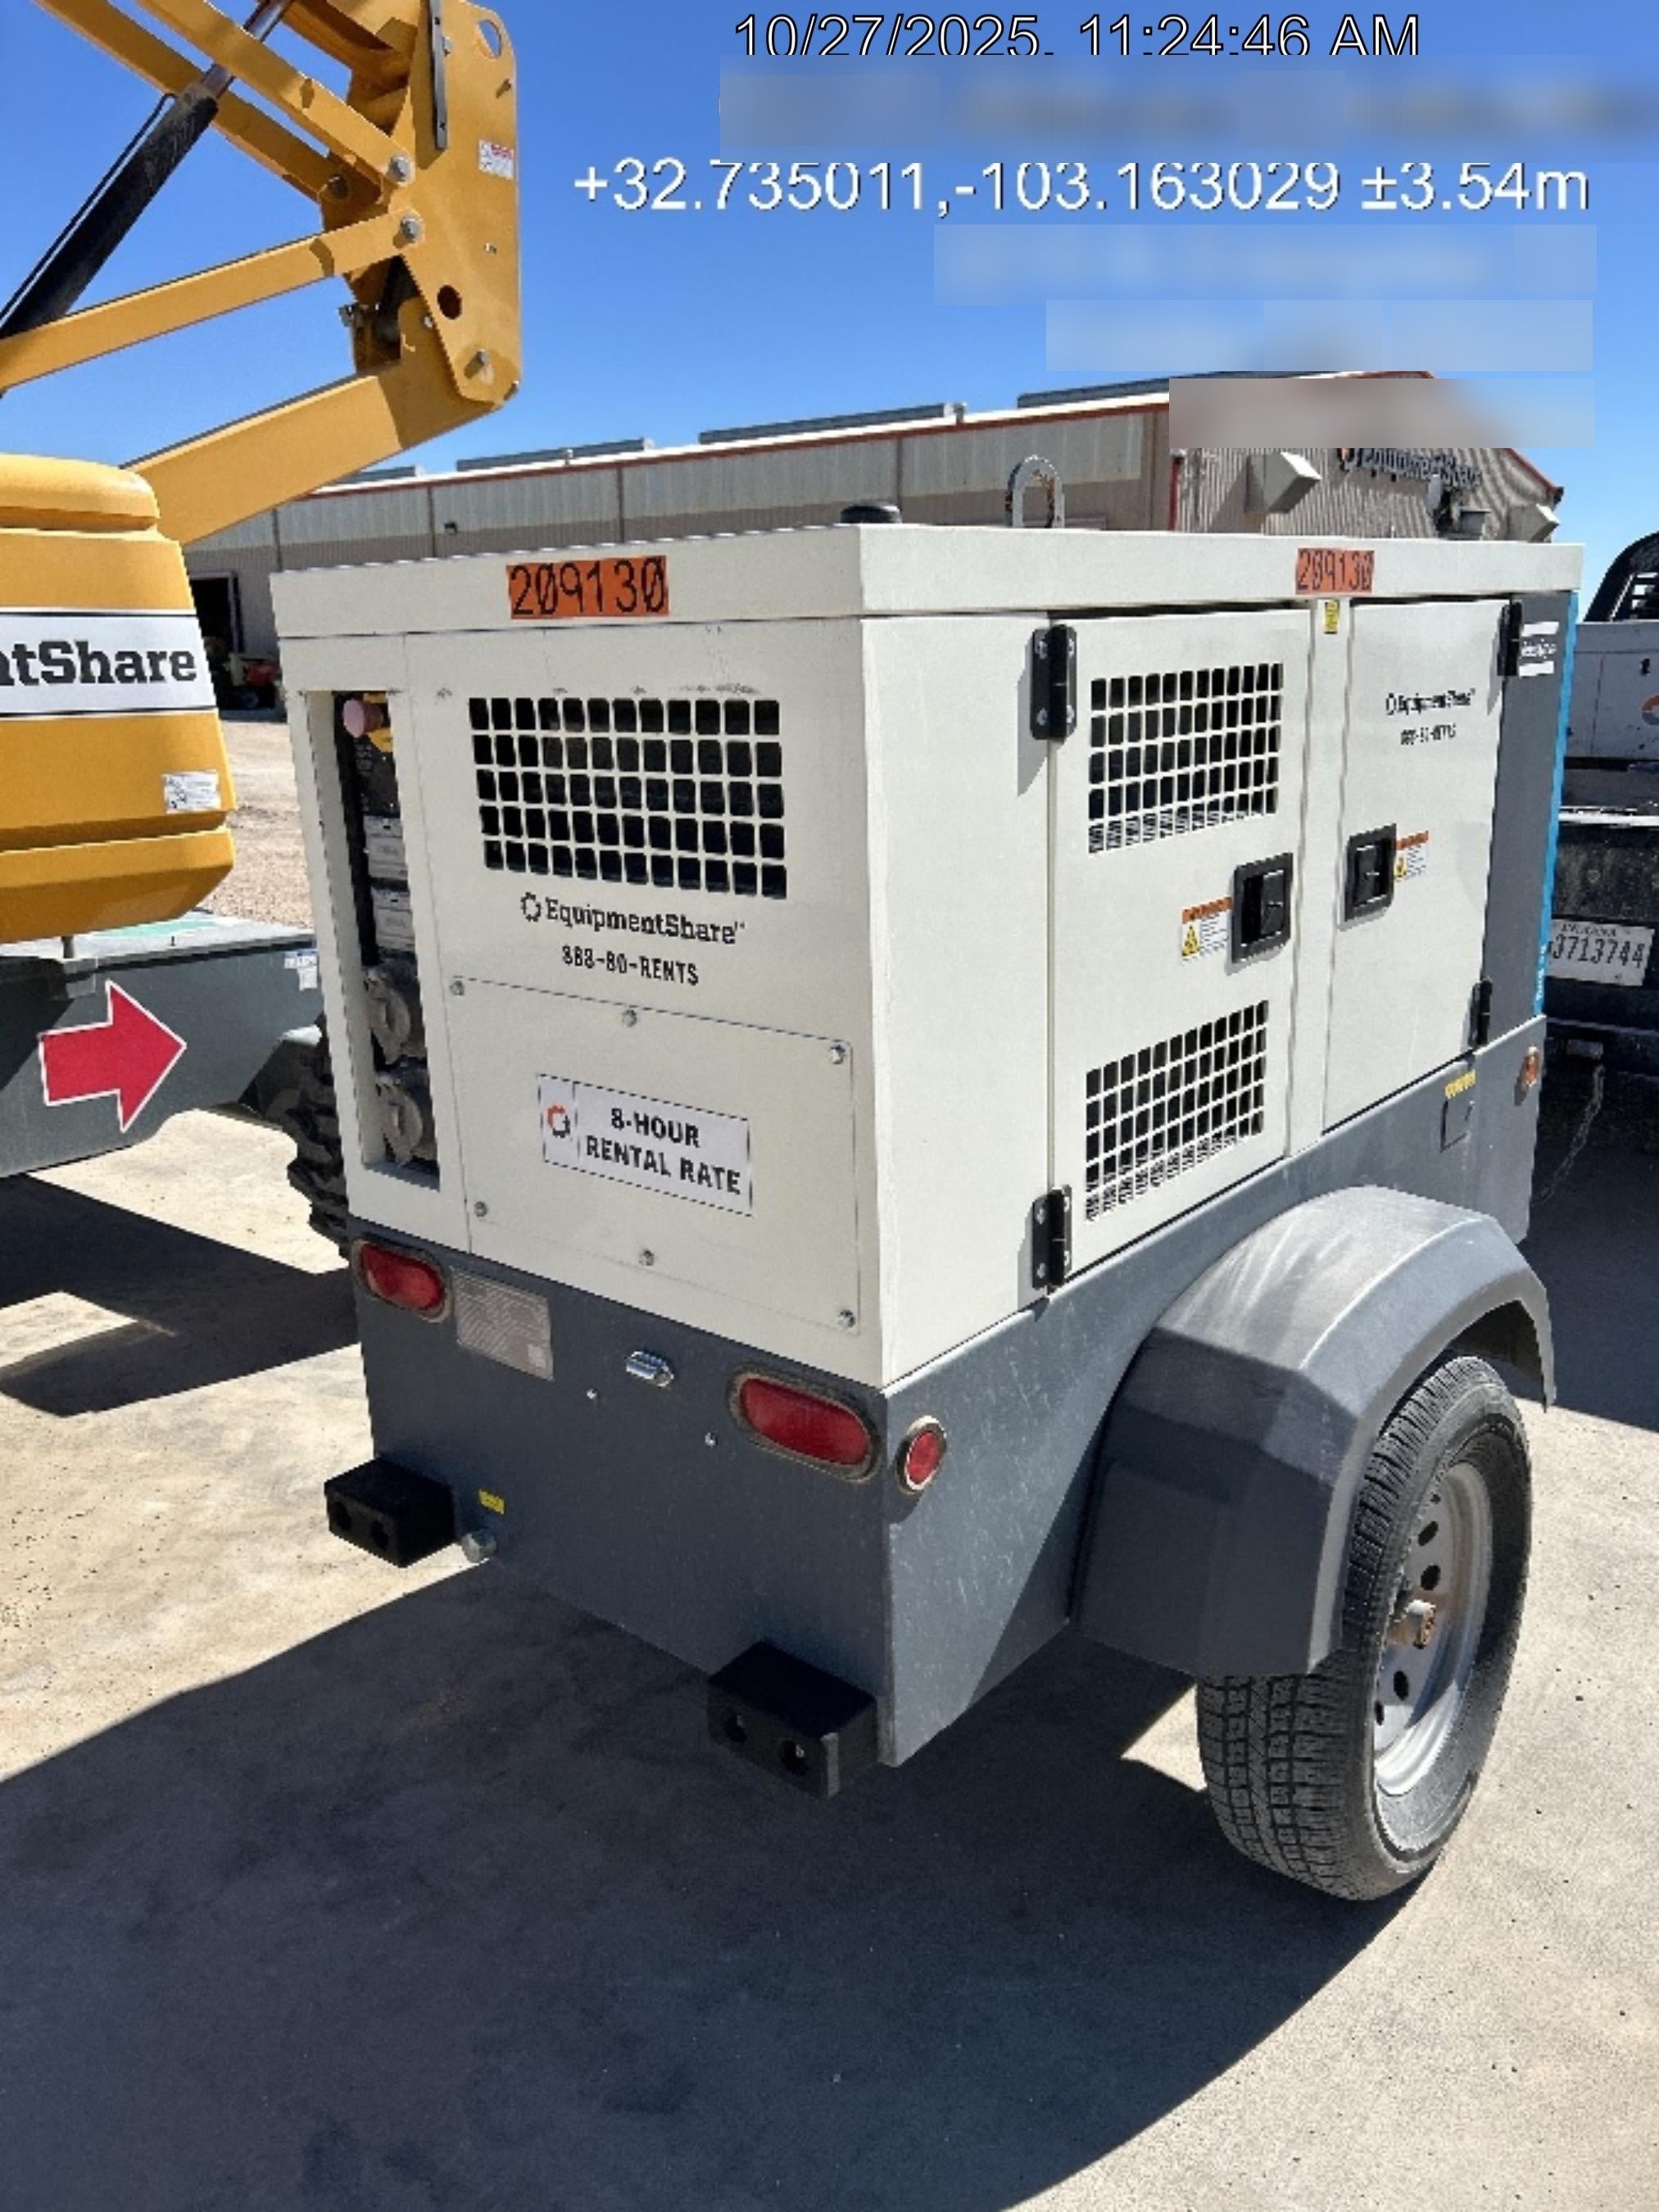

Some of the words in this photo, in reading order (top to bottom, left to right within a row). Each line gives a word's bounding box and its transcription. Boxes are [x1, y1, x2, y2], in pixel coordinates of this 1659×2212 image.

[510, 556, 666, 615] 209130
[1298, 550, 1373, 591] 209130
[610, 1108, 701, 1149] 8-HOUR
[586, 1135, 672, 1178] RENTAL
[679, 1156, 741, 1196] RATE
